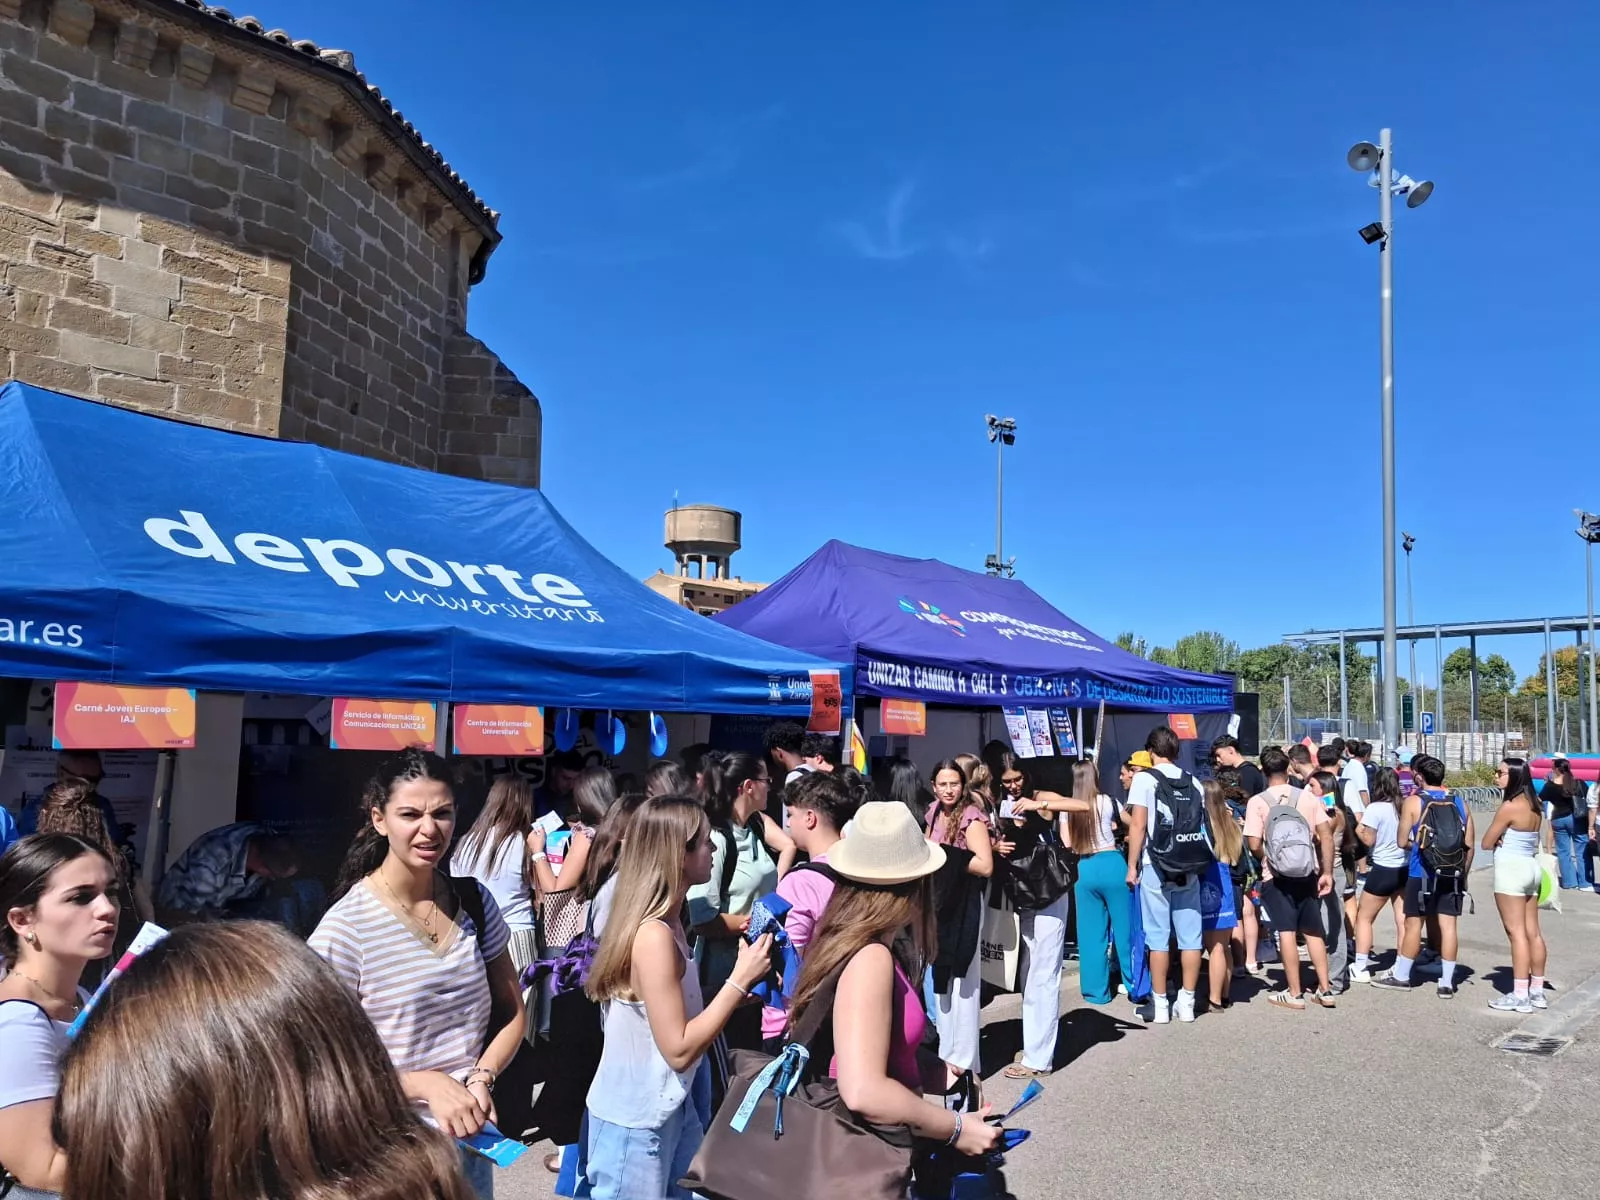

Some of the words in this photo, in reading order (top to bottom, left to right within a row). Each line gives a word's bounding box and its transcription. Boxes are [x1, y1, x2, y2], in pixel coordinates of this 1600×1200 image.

[143, 510, 593, 607] deporte
[384, 588, 605, 623] universitario
[787, 677, 812, 690] Unive
[868, 661, 910, 688] UNIZAR
[914, 666, 956, 693] CAMINA
[957, 671, 988, 695] HCIA
[989, 672, 1008, 696] LS
[1085, 679, 1103, 699] DE
[1103, 680, 1170, 704] DESARROLLO
[1171, 687, 1229, 705] SOSTENIBLE
[789, 691, 812, 702] Zarag
[74, 703, 103, 713] Carné
[105, 704, 133, 713] Joven
[134, 704, 172, 715] Europeo
[120, 715, 136, 724] IAJ
[343, 710, 372, 719] Servicio
[373, 712, 382, 720] de
[383, 711, 420, 722] Informática
[343, 719, 400, 730] Comunicaciones
[400, 722, 427, 731] UNIZAR
[466, 719, 488, 728] Centro
[488, 720, 497, 728] de
[497, 719, 533, 728] Información
[481, 727, 520, 737] Universitaria
[981, 939, 1004, 951] ARNÉ
